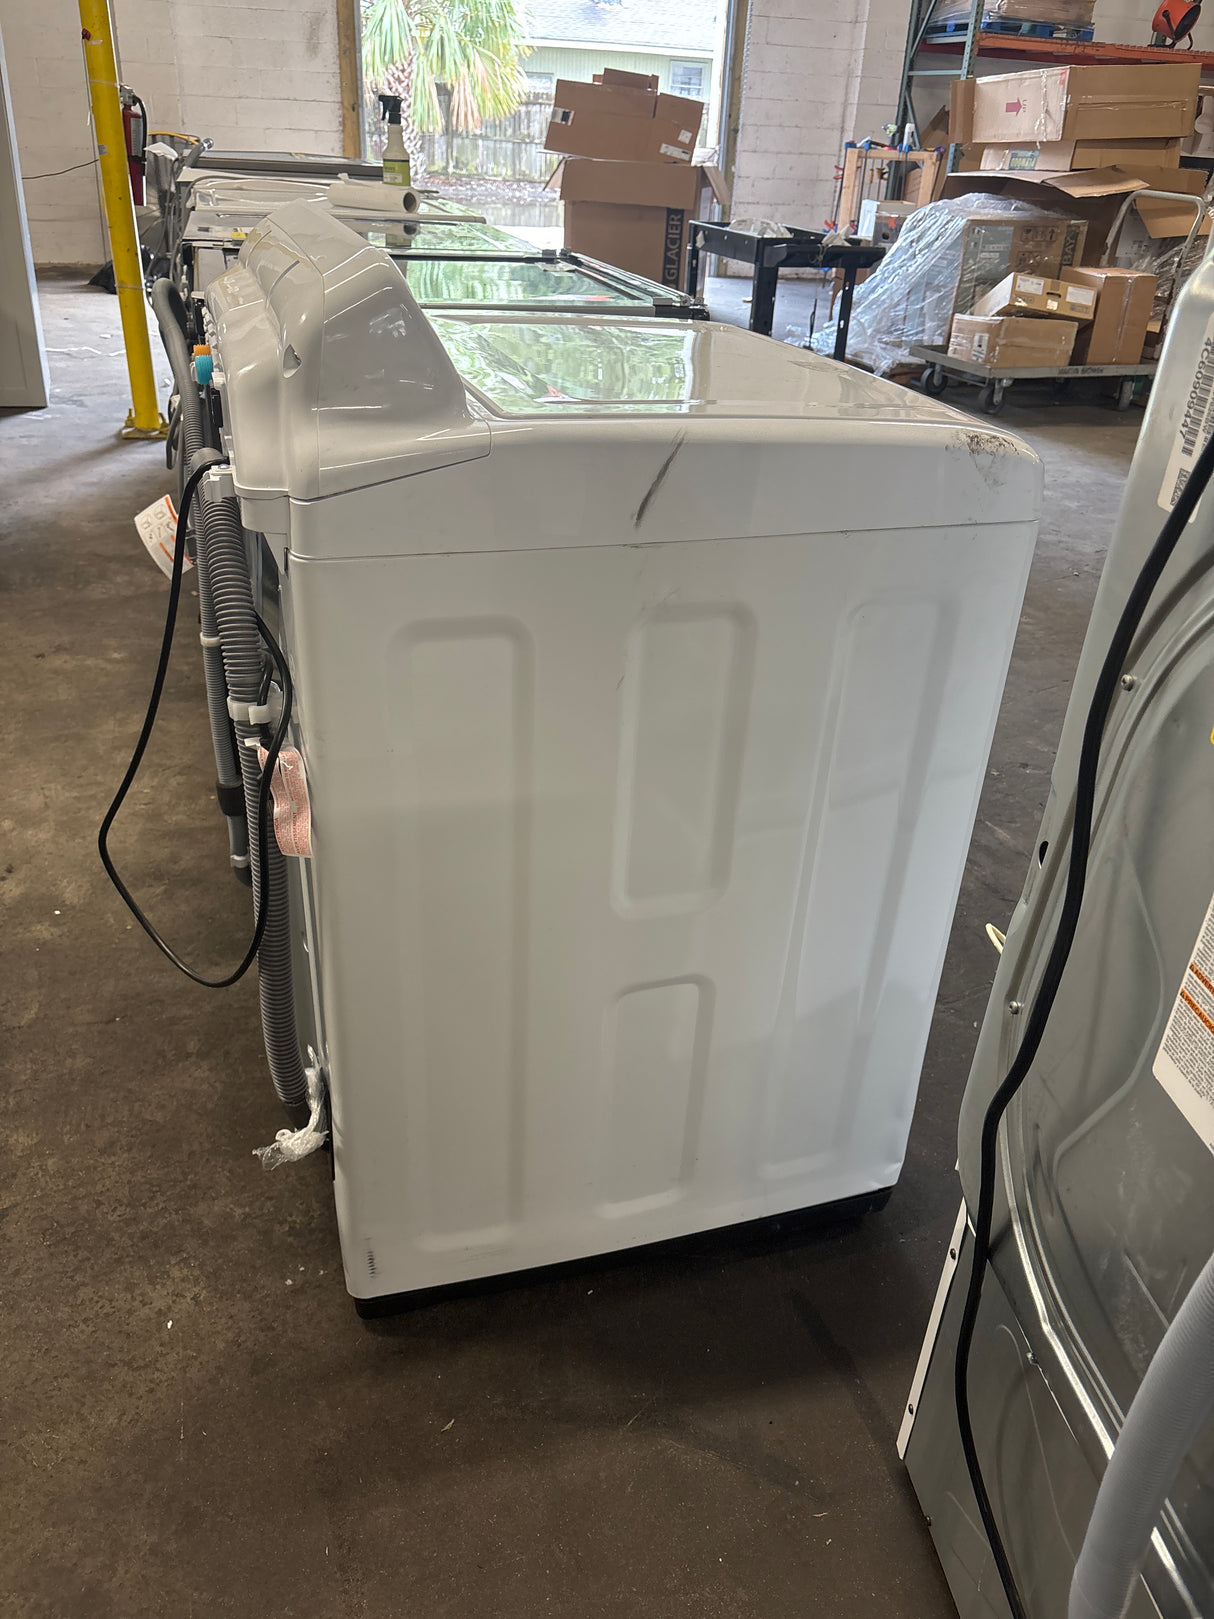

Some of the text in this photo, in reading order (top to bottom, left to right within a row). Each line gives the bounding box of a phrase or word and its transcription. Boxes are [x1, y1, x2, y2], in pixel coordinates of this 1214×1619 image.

[665, 214, 681, 280] GLACIER
[1062, 236, 1076, 265] BAY
[1179, 336, 1212, 442] 4C60909447
[1194, 968, 1214, 995] ADVER
